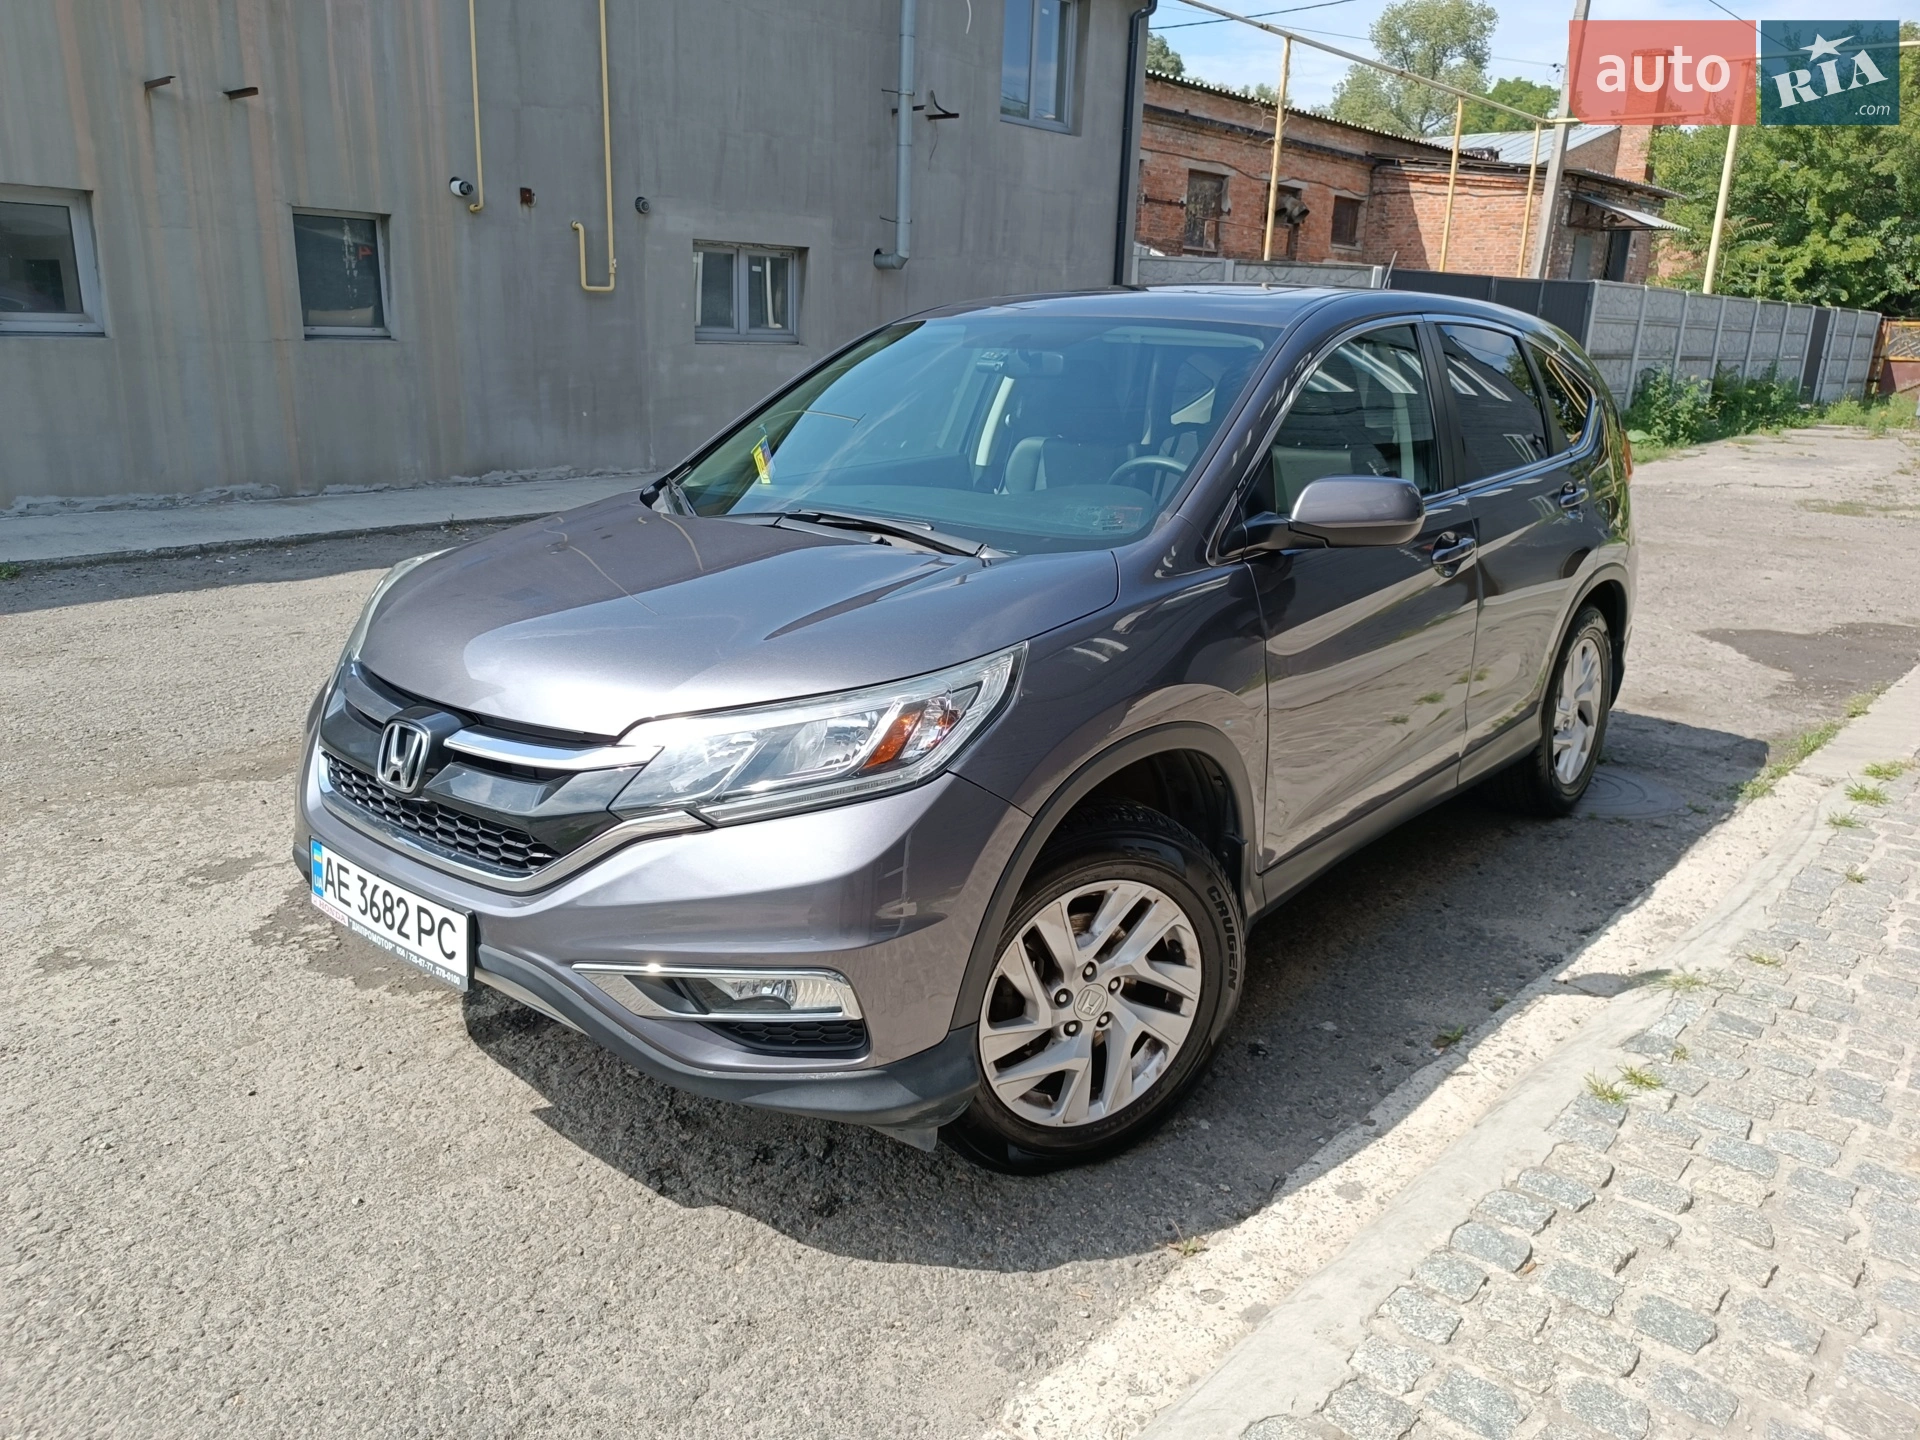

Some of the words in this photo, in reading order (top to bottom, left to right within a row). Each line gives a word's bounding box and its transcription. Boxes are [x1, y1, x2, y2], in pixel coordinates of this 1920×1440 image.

[314, 874, 323, 890] UA
[318, 900, 347, 924] HONDA
[325, 857, 352, 908] AE
[357, 875, 411, 941] 3682
[417, 905, 457, 961] PC
[1206, 886, 1238, 991] CRUGEN
